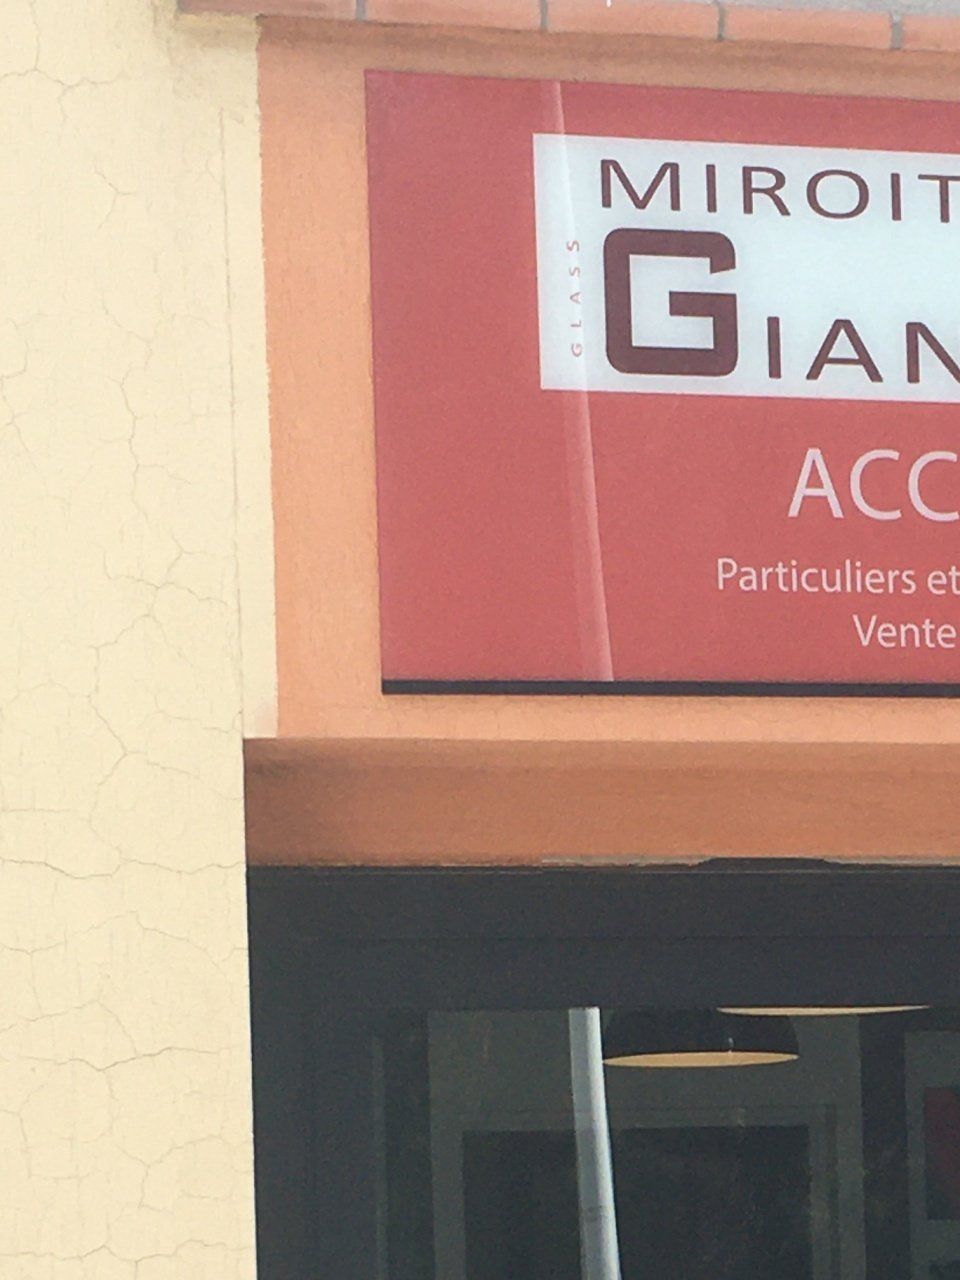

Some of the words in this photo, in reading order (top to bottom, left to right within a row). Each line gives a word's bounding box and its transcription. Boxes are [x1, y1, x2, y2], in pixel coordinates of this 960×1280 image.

[566, 239, 583, 358] GLASS
[716, 557, 917, 595] Particuliers
[852, 614, 957, 649] Vente
